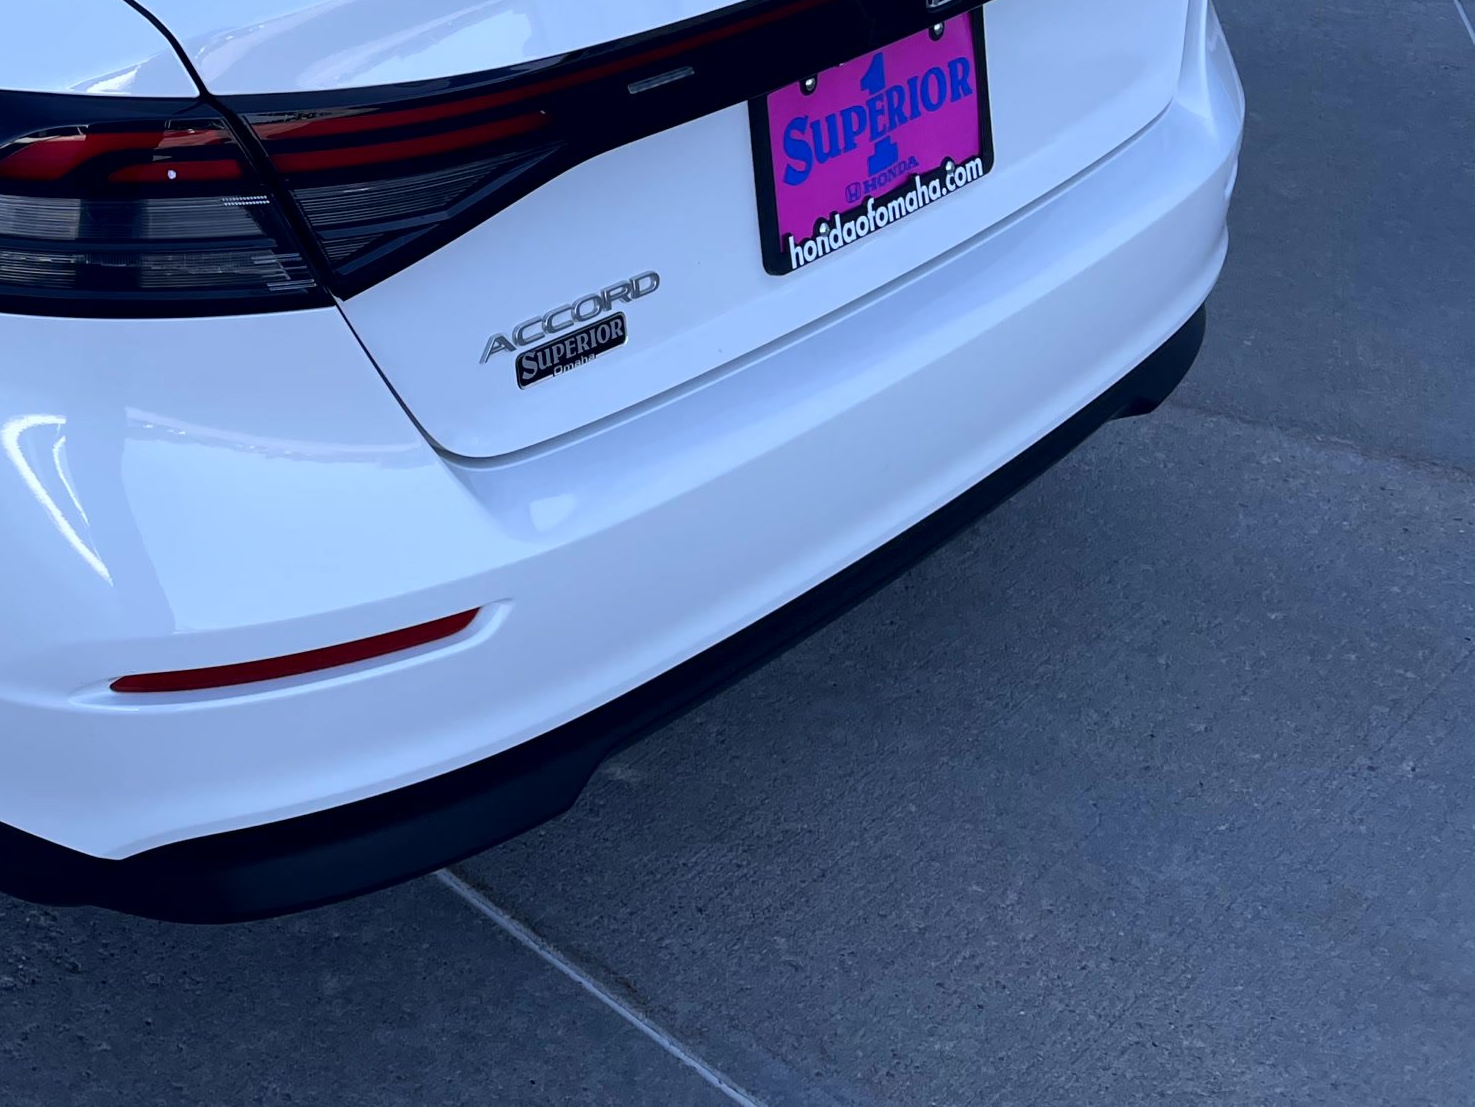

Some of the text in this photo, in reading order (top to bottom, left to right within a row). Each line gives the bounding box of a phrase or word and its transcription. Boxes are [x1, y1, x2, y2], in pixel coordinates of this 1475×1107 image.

[782, 56, 974, 187] SUPERIOR
[788, 156, 985, 270] hondaofomaha.com
[863, 156, 919, 195] HONDA
[479, 270, 660, 364] ACCORD
[521, 317, 624, 380] SUPERIOR
